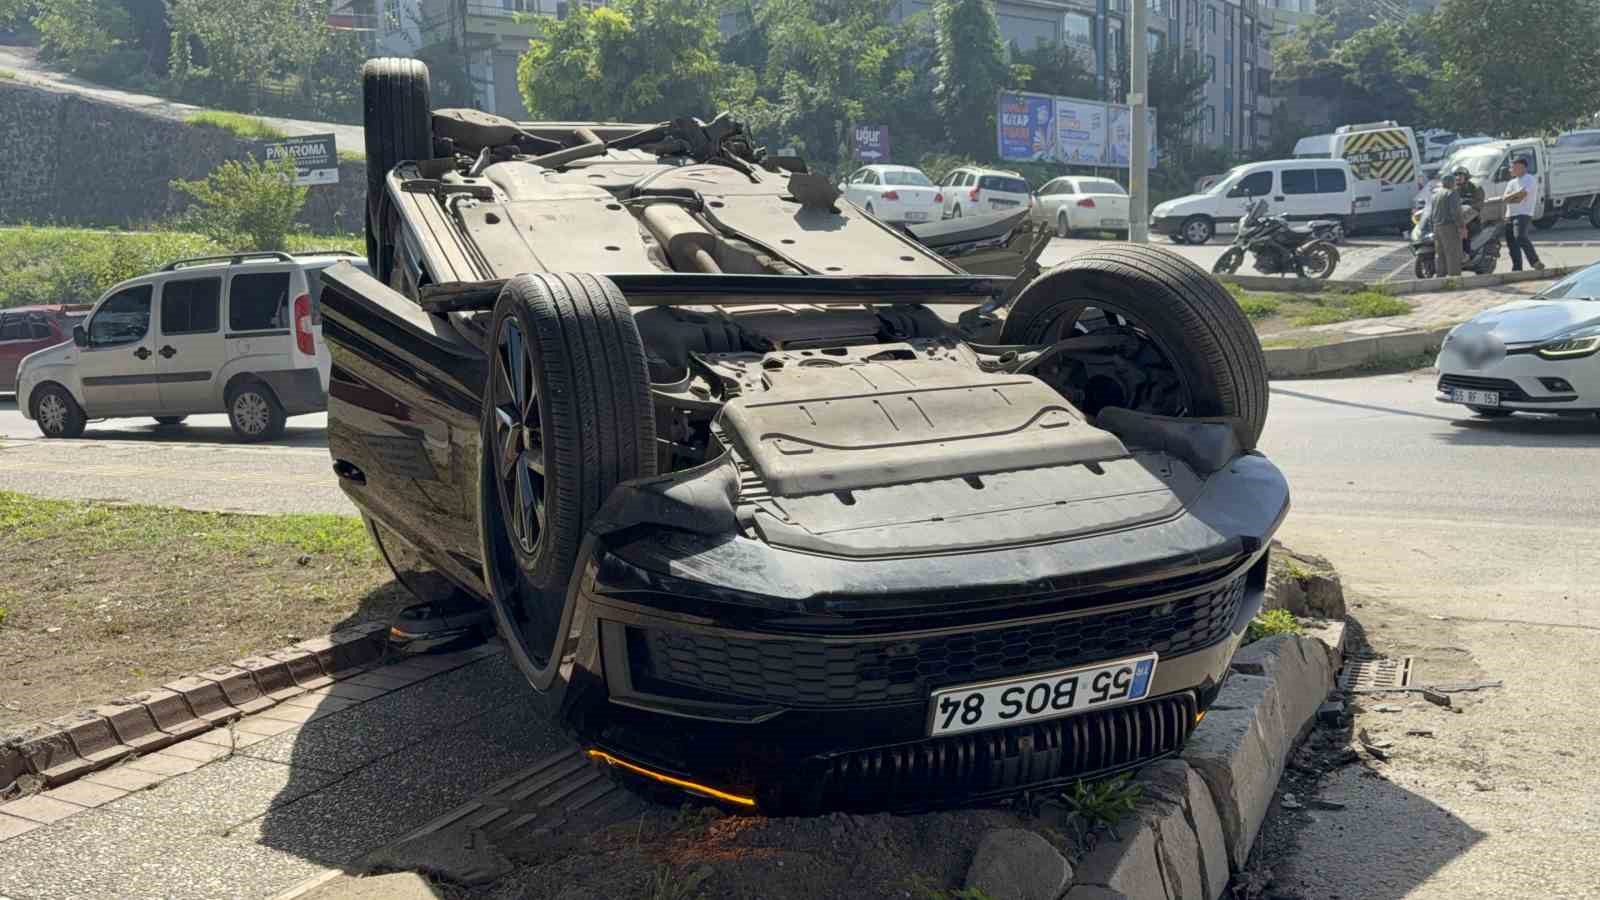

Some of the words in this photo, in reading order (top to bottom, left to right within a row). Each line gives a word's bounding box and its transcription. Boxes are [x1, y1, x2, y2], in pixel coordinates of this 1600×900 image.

[998, 676, 1079, 719] BOS
[1088, 667, 1133, 704] 55
[940, 692, 985, 729] 84
